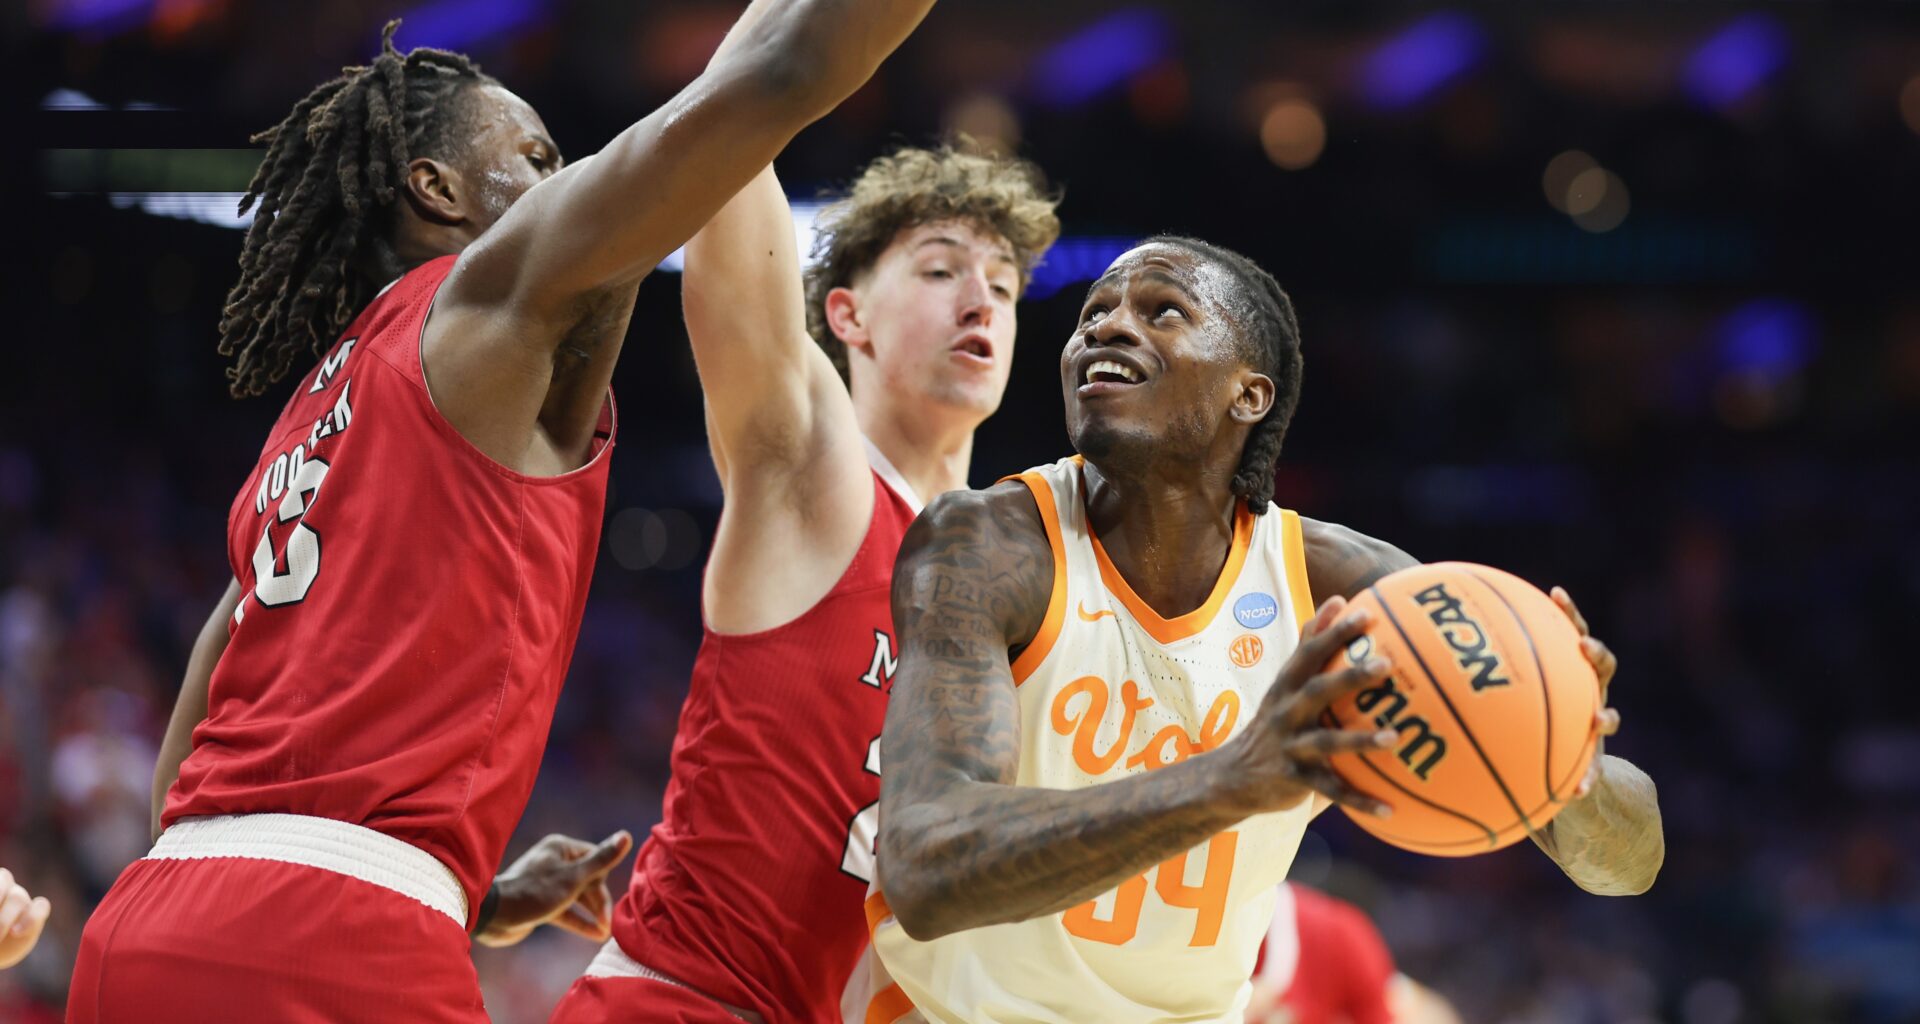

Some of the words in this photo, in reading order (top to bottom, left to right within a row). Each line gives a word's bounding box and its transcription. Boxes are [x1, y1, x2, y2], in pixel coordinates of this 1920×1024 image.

[1240, 606, 1276, 621] NCAA
[1412, 582, 1512, 692] NCAA
[1231, 636, 1261, 665] SEC
[1050, 674, 1241, 777] Vol
